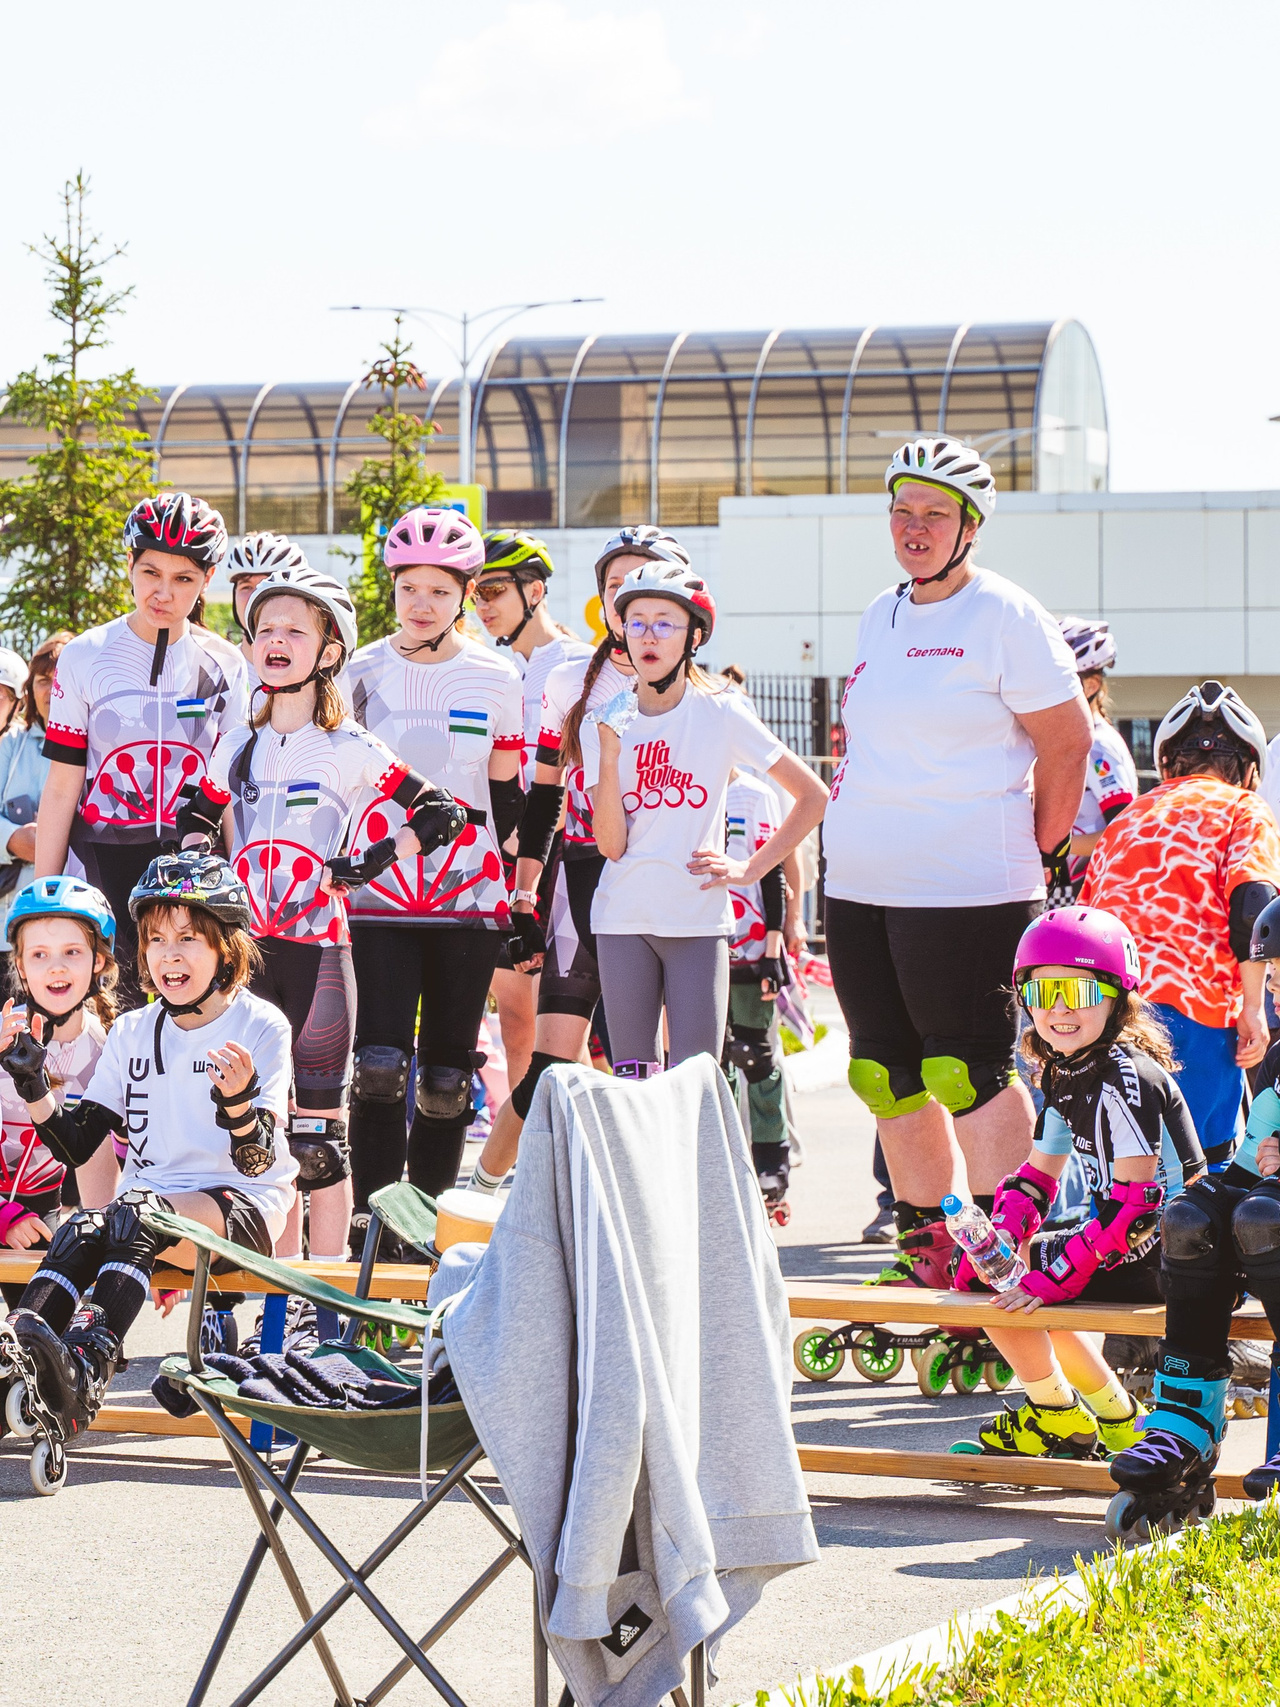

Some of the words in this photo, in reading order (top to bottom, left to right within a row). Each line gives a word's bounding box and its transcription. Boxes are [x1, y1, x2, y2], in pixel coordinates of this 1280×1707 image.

[906, 647, 965, 658] Светлана
[633, 739, 671, 770] Ufa
[1040, 1237, 1049, 1273] POWERS
[620, 1625, 641, 1647] adidas
